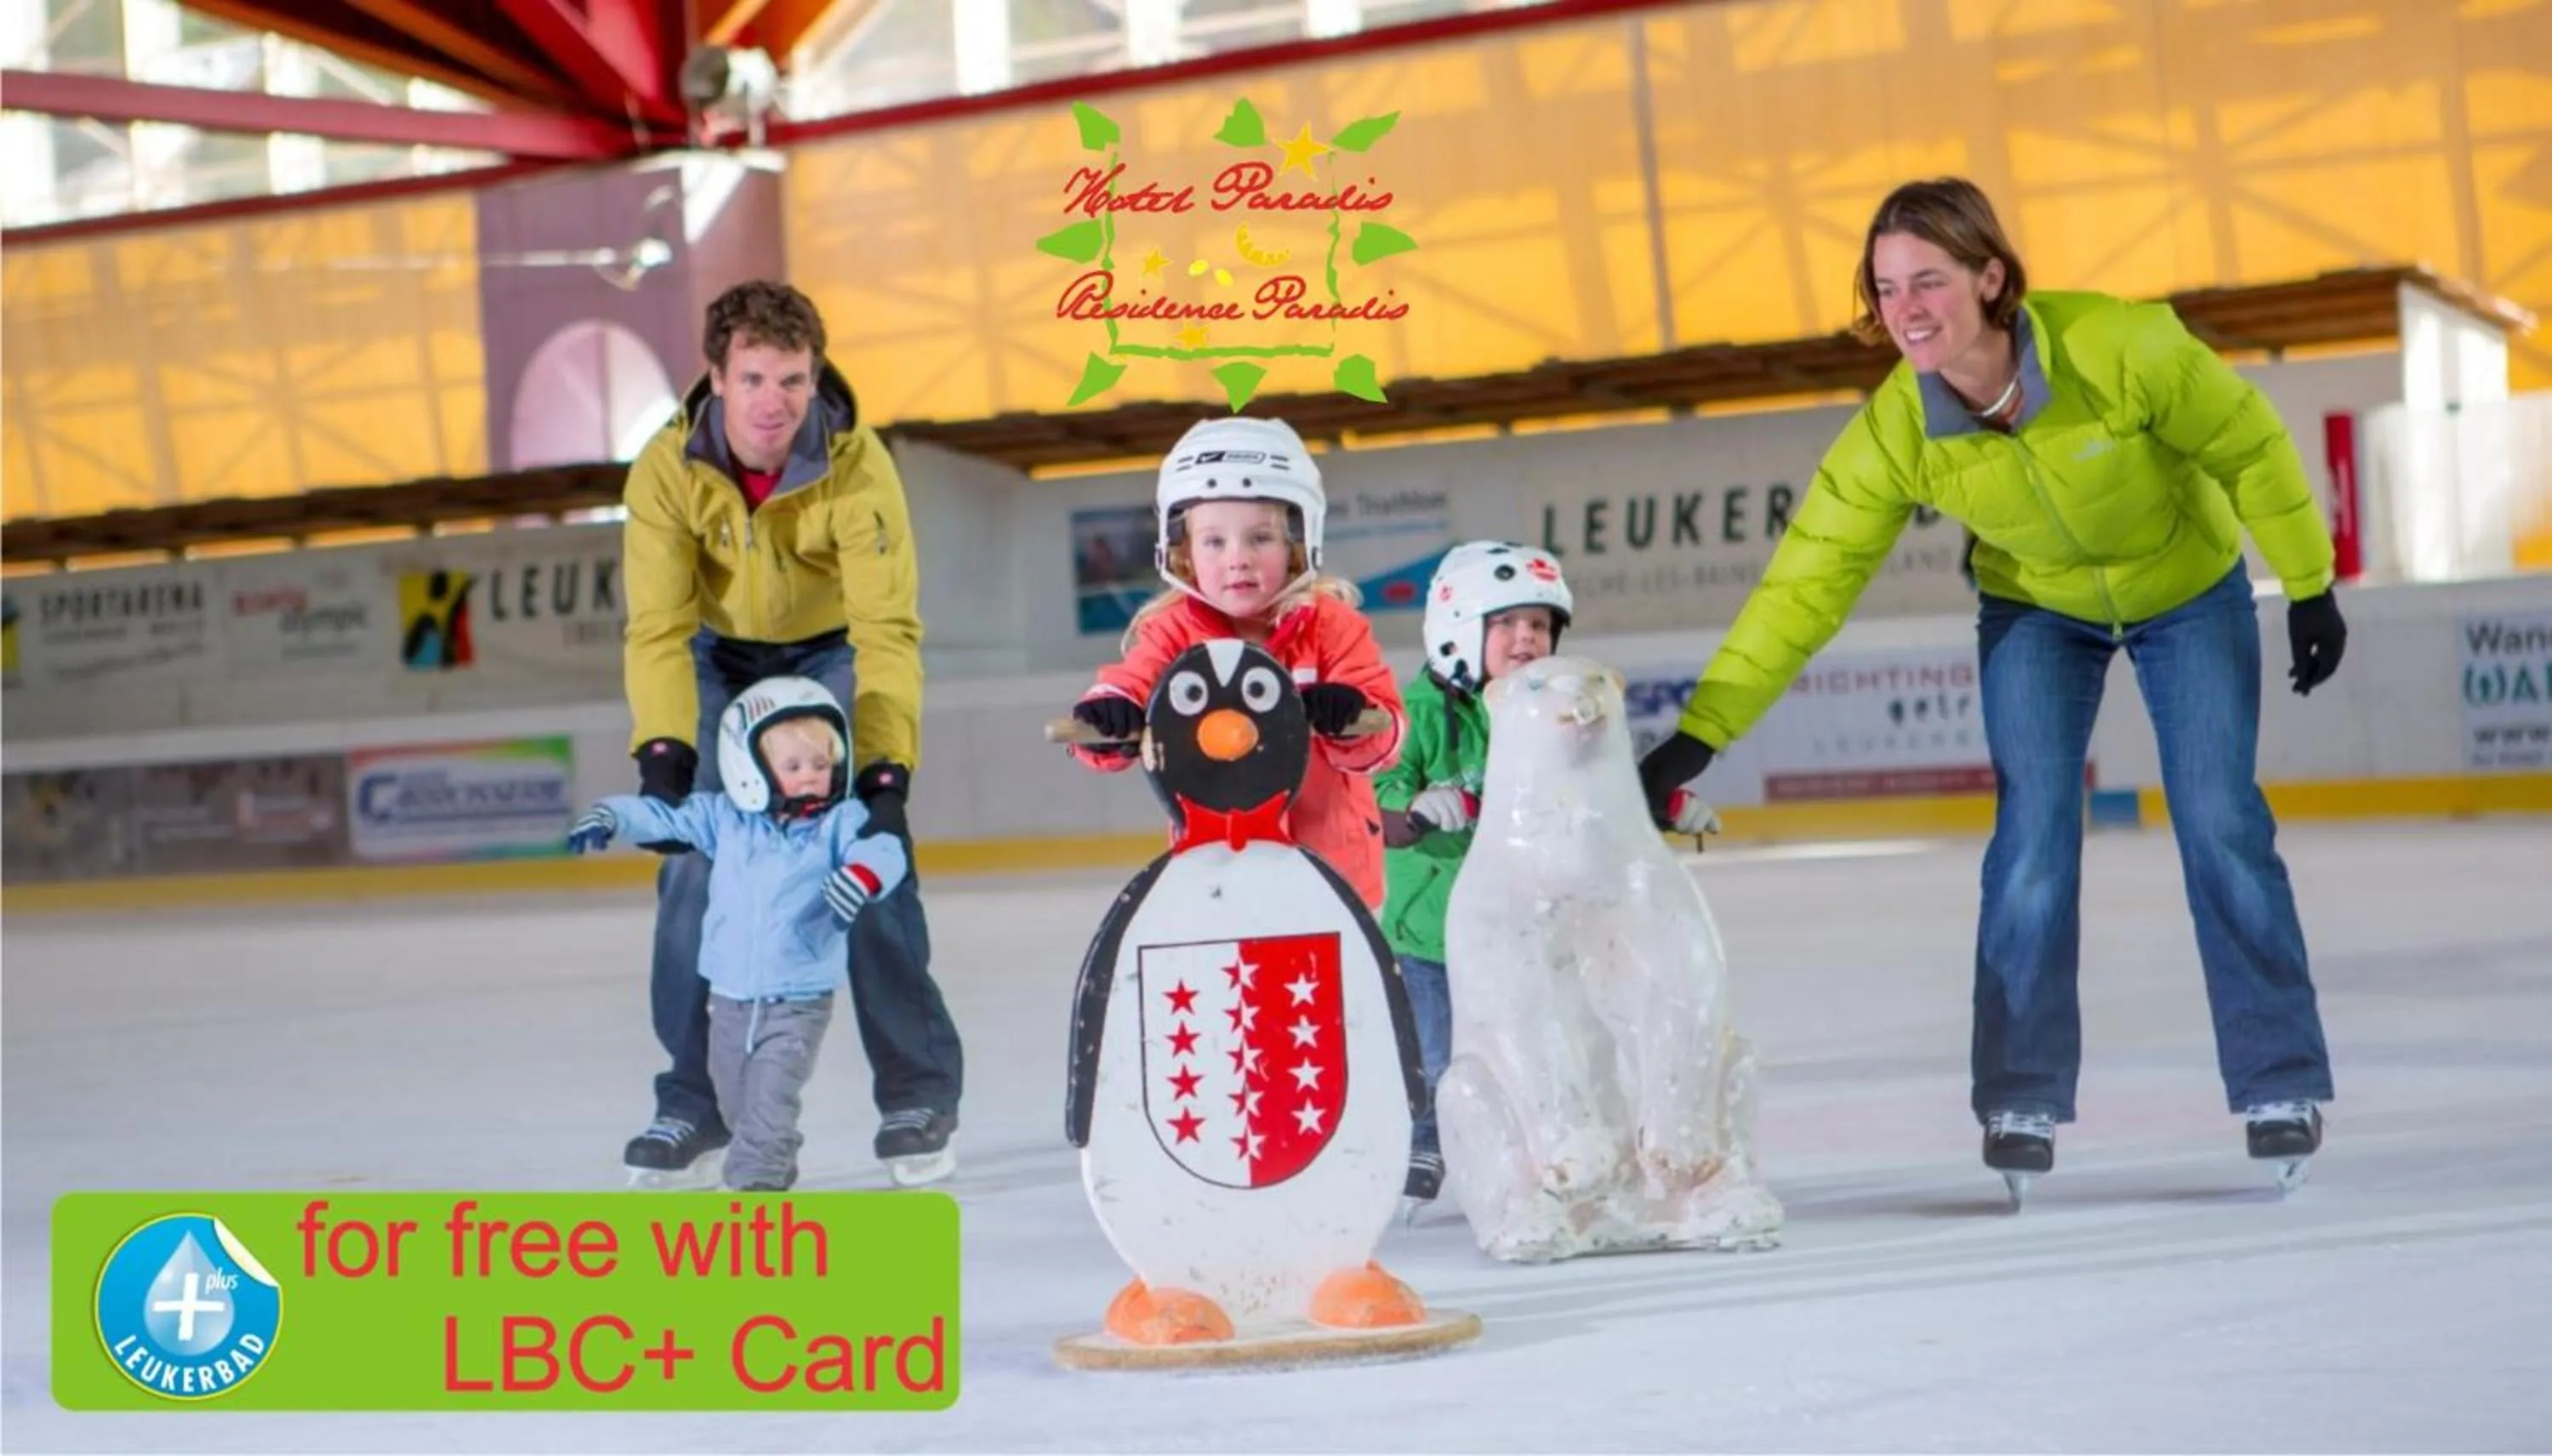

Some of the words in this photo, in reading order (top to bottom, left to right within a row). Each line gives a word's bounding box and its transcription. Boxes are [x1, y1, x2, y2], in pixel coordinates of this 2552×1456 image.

[1541, 483, 1793, 558] LEUKER
[491, 558, 618, 622] LEUK
[2464, 618, 2552, 657] Wan
